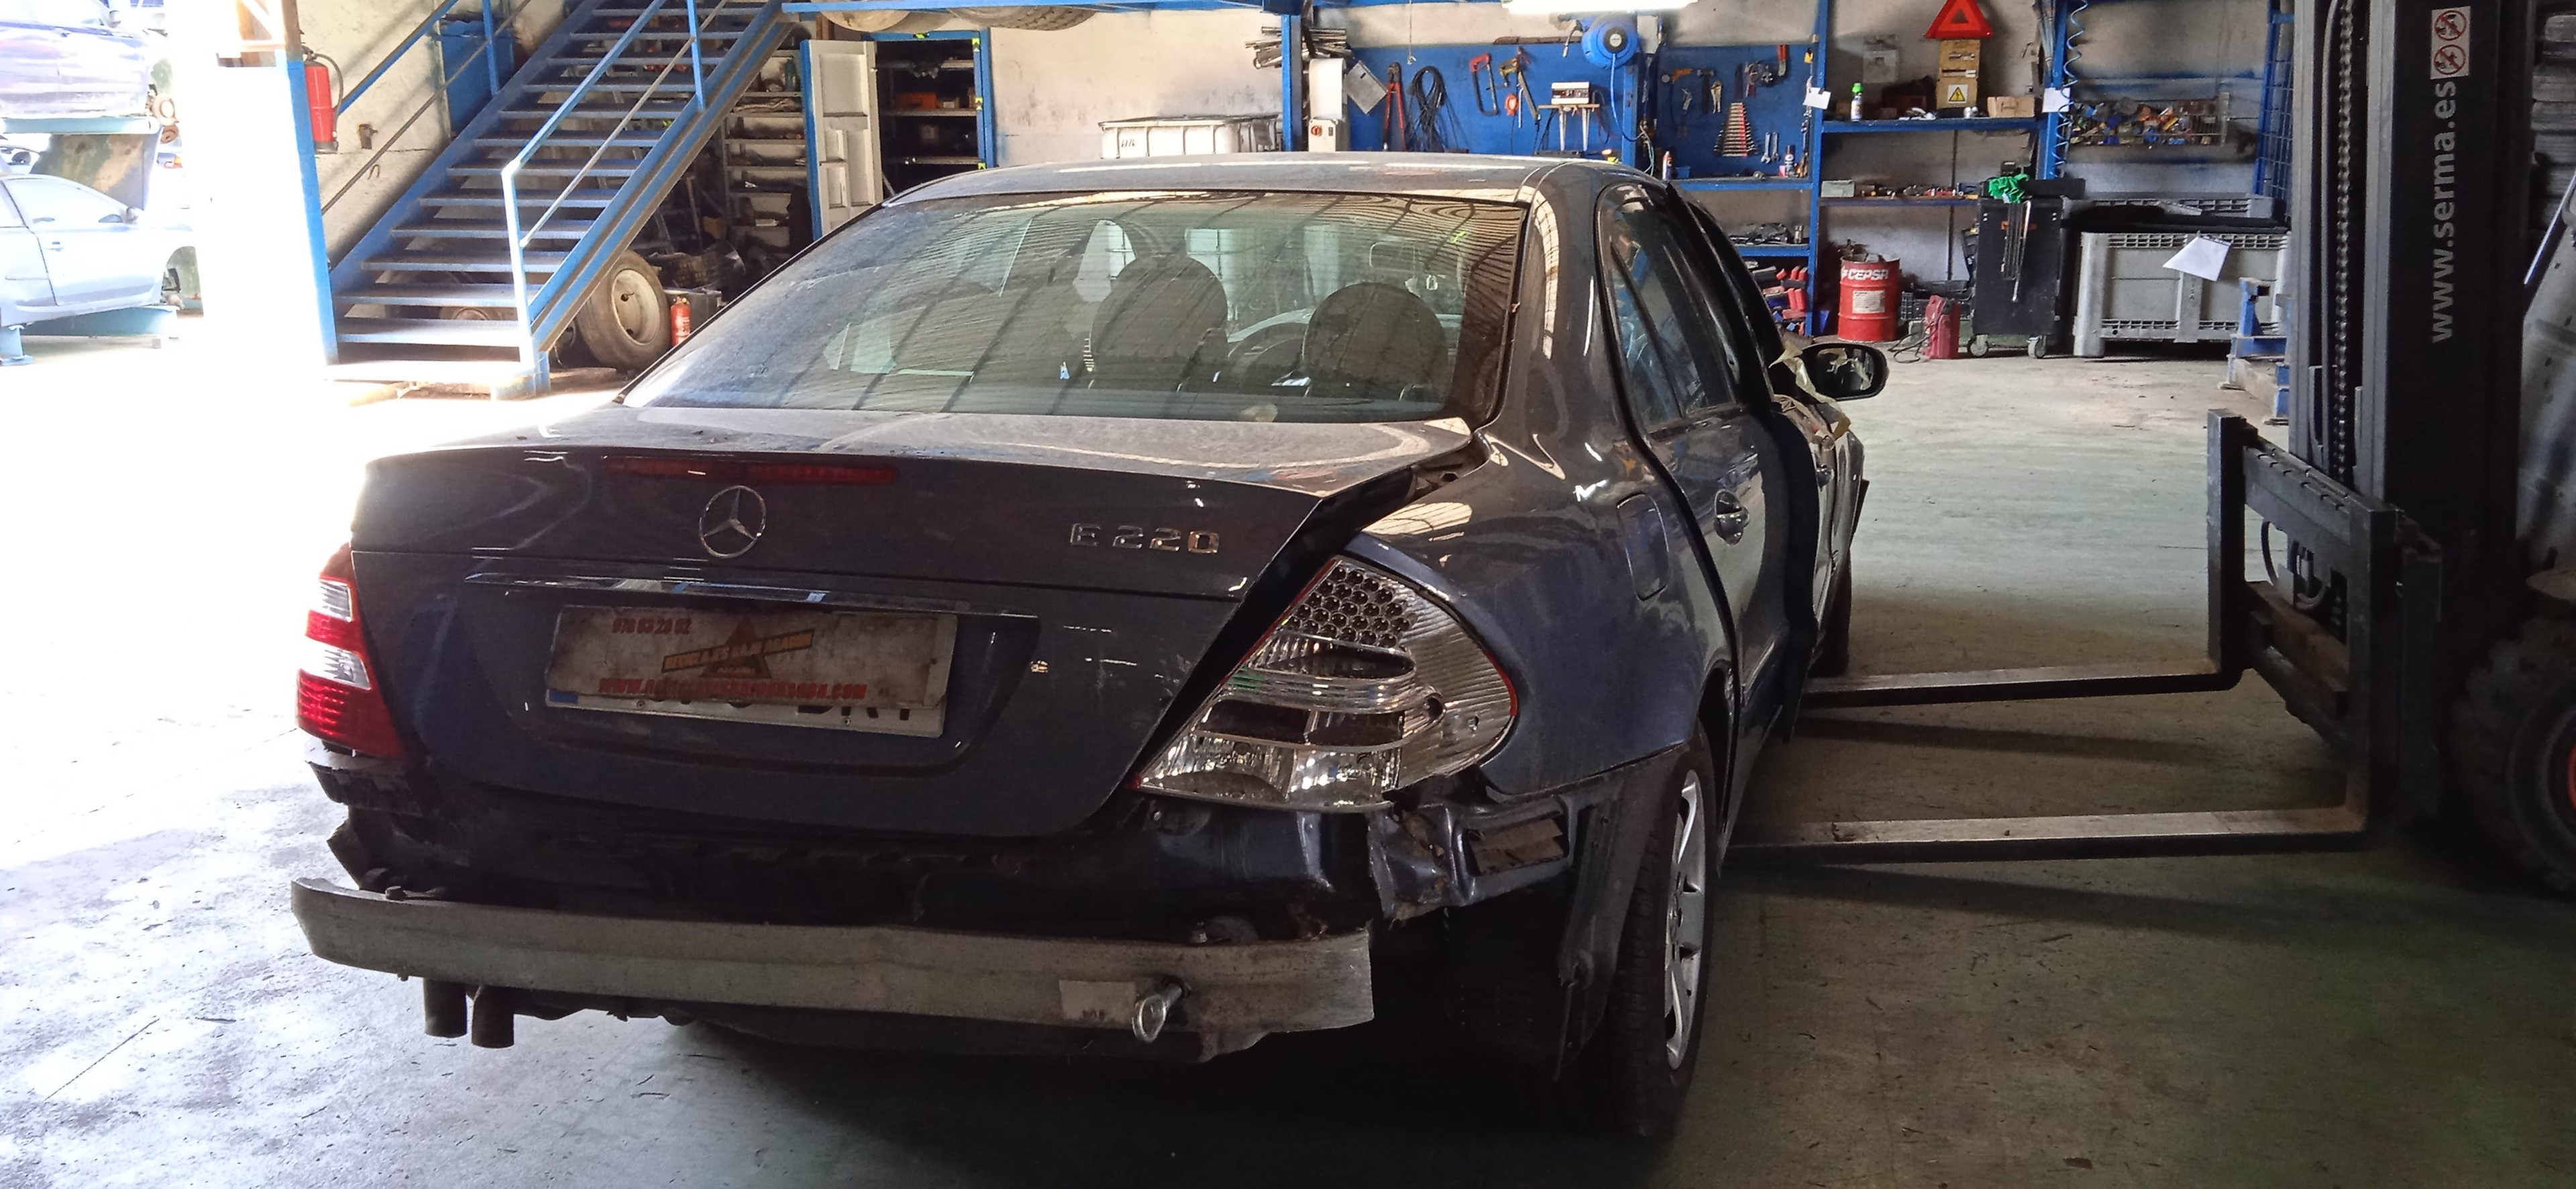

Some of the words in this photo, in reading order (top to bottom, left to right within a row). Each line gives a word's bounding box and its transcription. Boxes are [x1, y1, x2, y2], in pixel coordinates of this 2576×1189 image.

[2432, 80, 2456, 344] www.serma.es
[1847, 268, 1889, 280] CEPSA
[1069, 522, 1102, 547] E
[1112, 524, 1220, 554] 220
